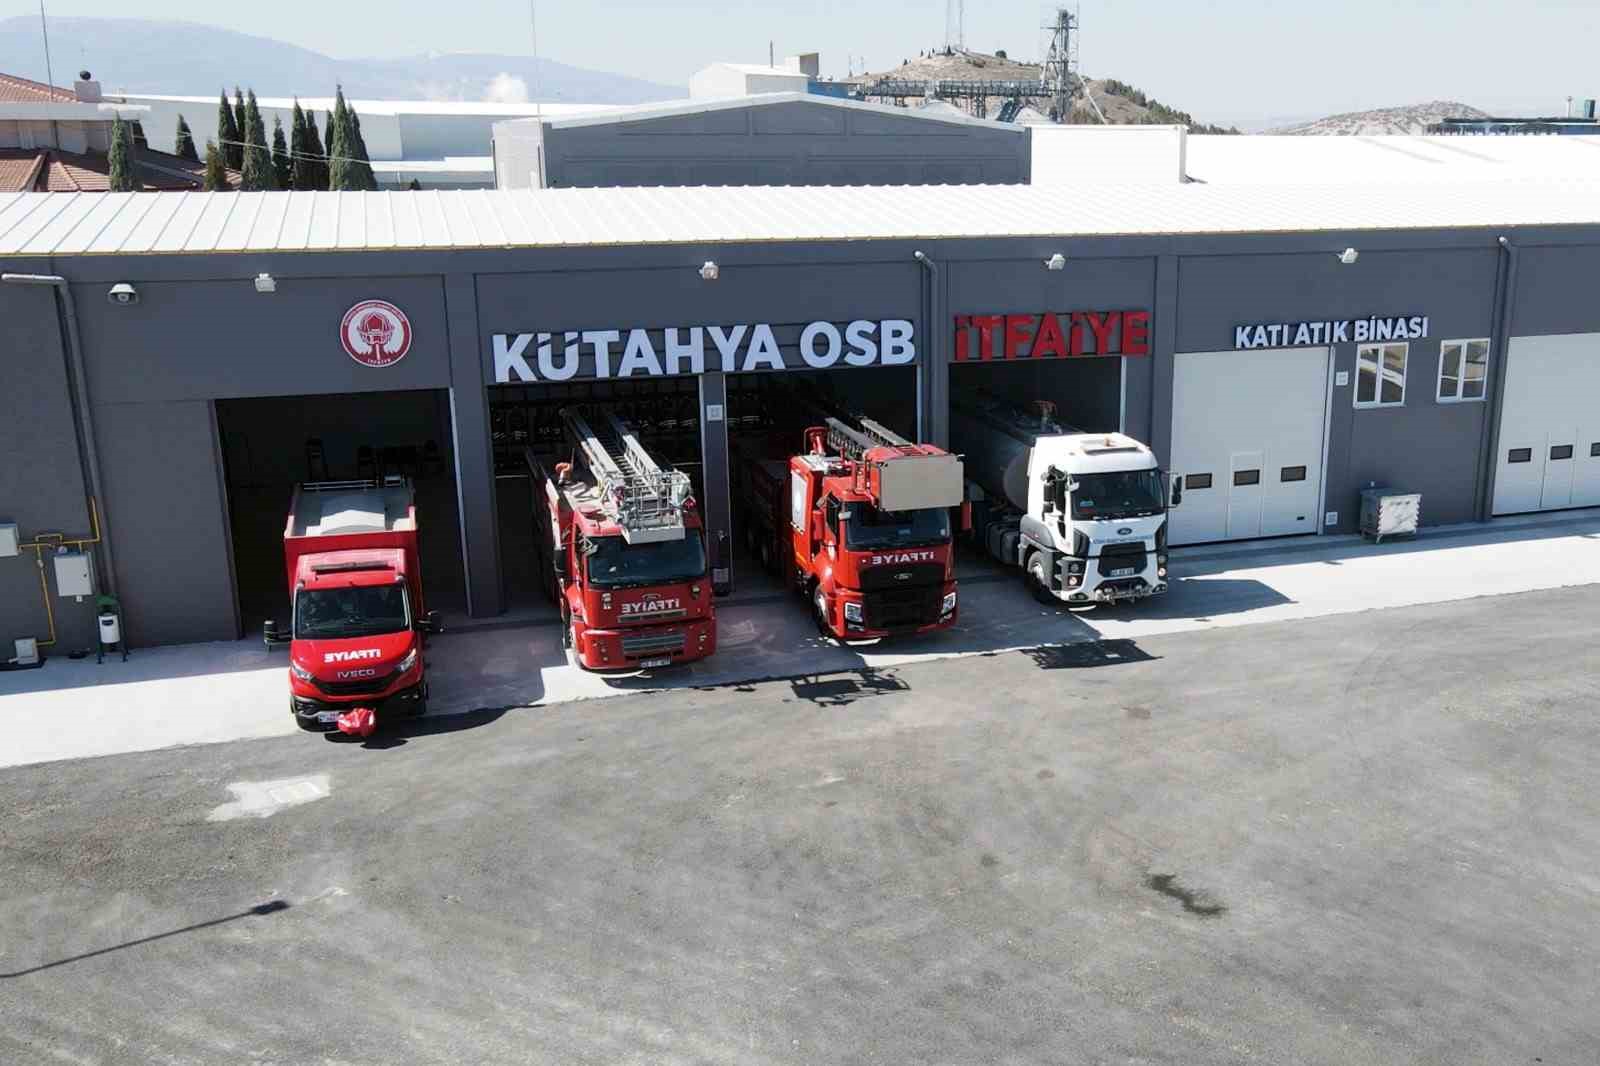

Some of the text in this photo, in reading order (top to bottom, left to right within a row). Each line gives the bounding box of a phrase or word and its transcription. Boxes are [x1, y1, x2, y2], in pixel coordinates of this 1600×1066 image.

[492, 318, 916, 384] KÜTAHYA OSB
[954, 310, 1152, 362] İTFAİYE
[1235, 315, 1430, 349] KATI ATIK BİNASI
